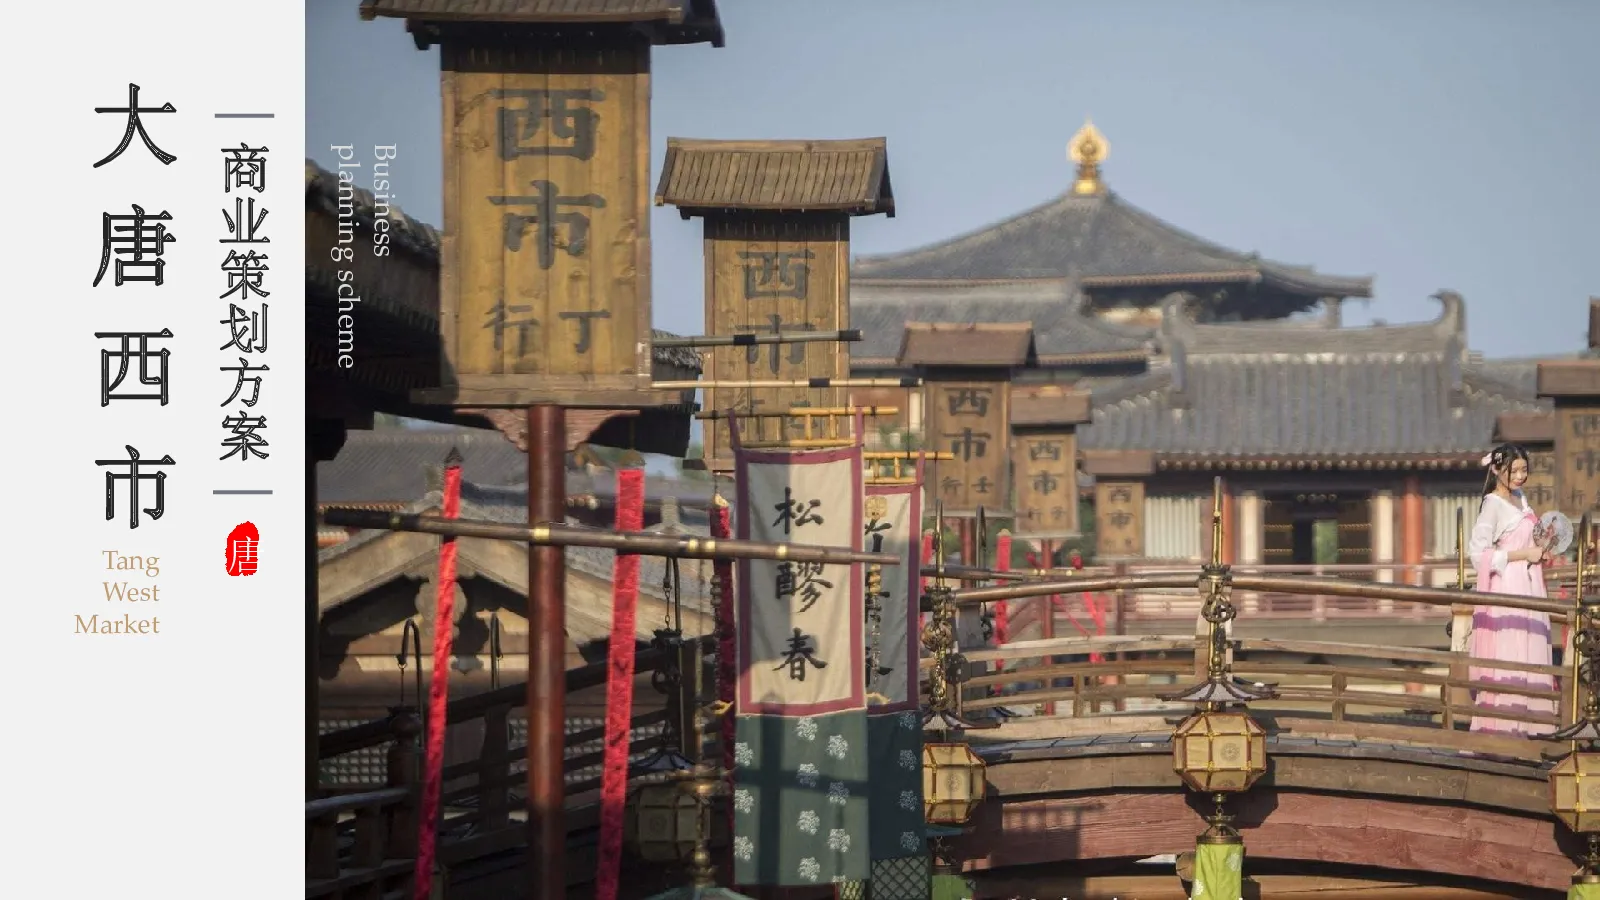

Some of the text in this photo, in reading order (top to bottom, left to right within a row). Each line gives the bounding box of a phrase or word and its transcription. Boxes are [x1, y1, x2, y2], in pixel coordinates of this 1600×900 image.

[487, 88, 606, 270] 西市
[737, 249, 815, 375] 西市
[942, 387, 992, 462] 西市
